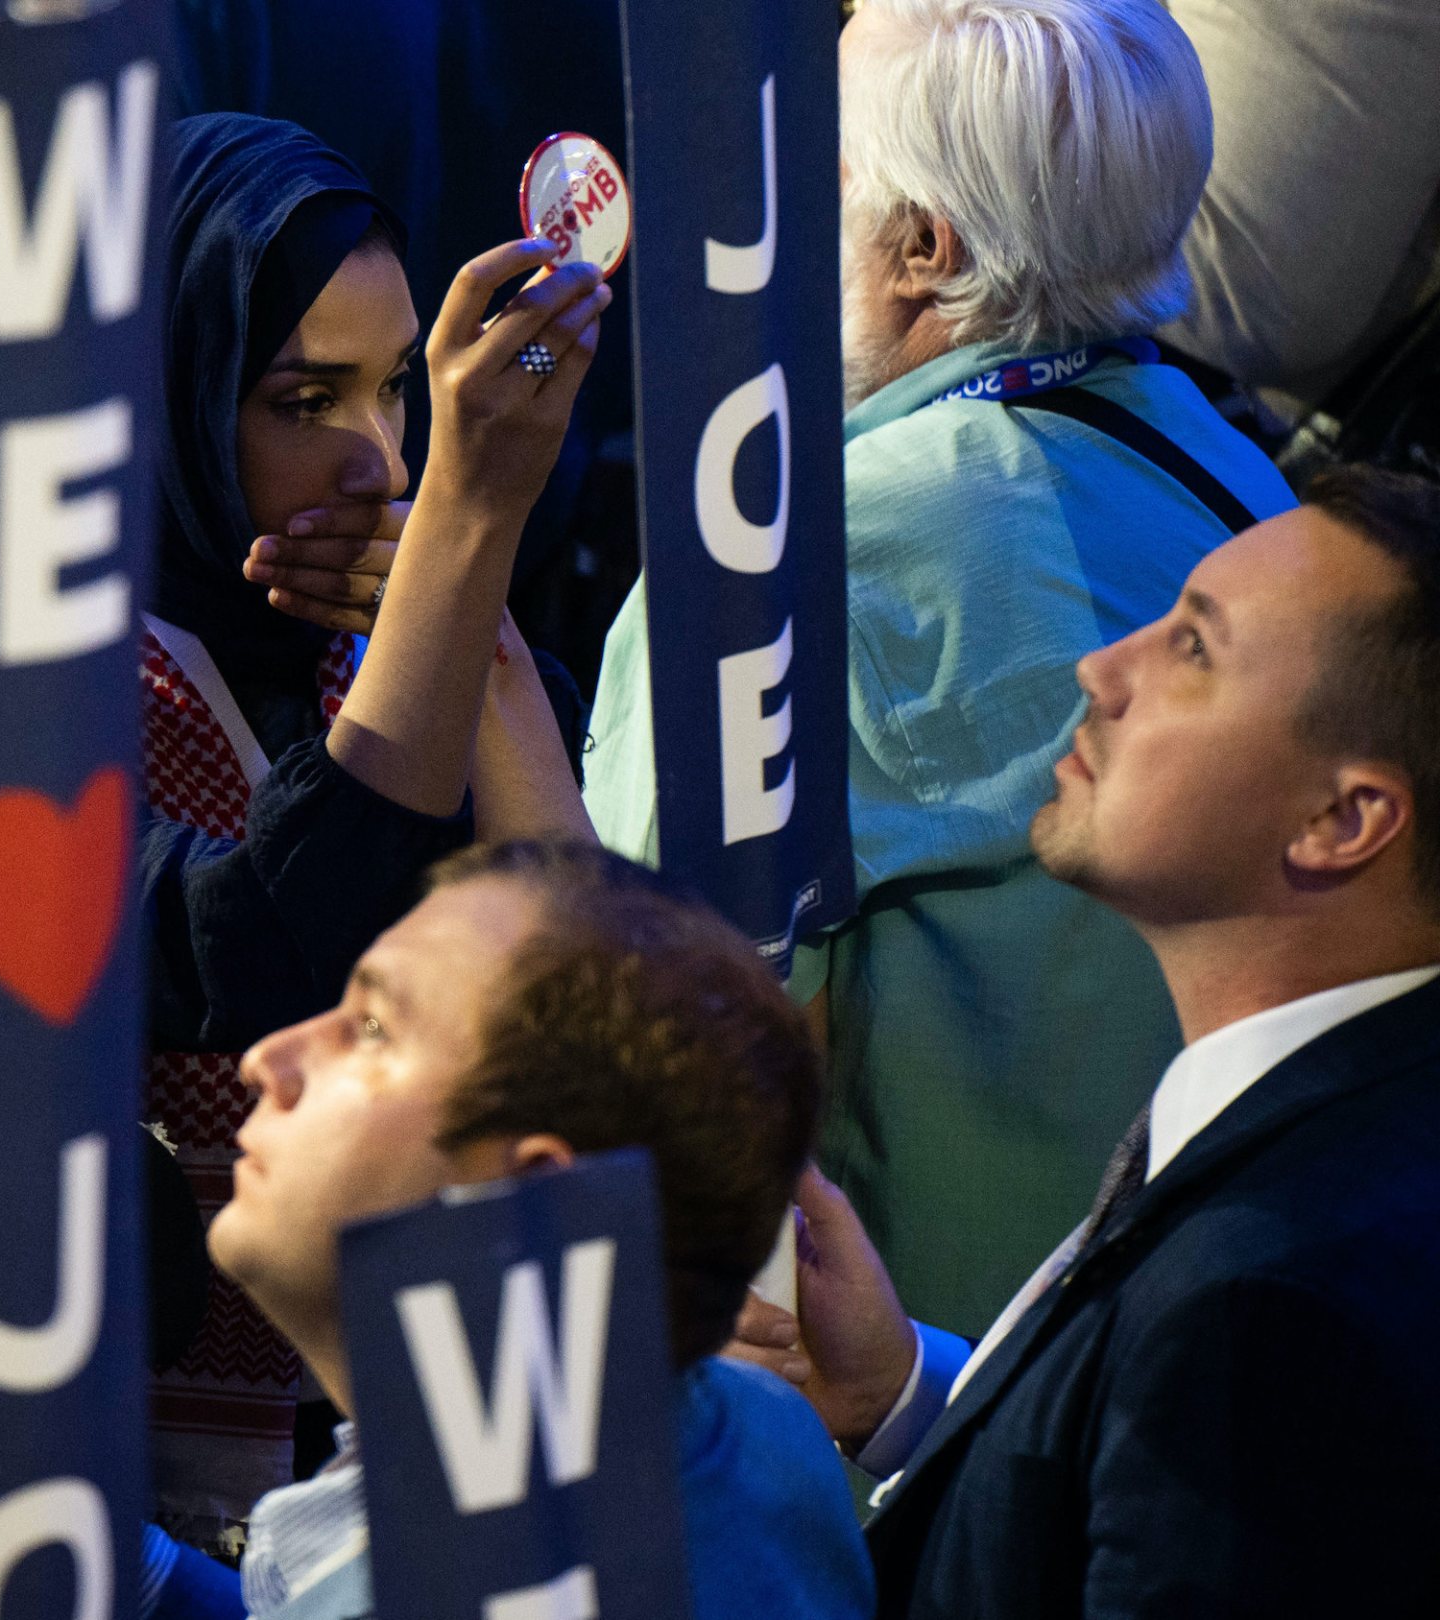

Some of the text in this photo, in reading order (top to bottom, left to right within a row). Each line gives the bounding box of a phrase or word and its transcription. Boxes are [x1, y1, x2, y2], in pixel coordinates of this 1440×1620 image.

[694, 73, 796, 846] JOE
[931, 348, 1088, 406] DNC 202
[393, 1236, 619, 1620] W
